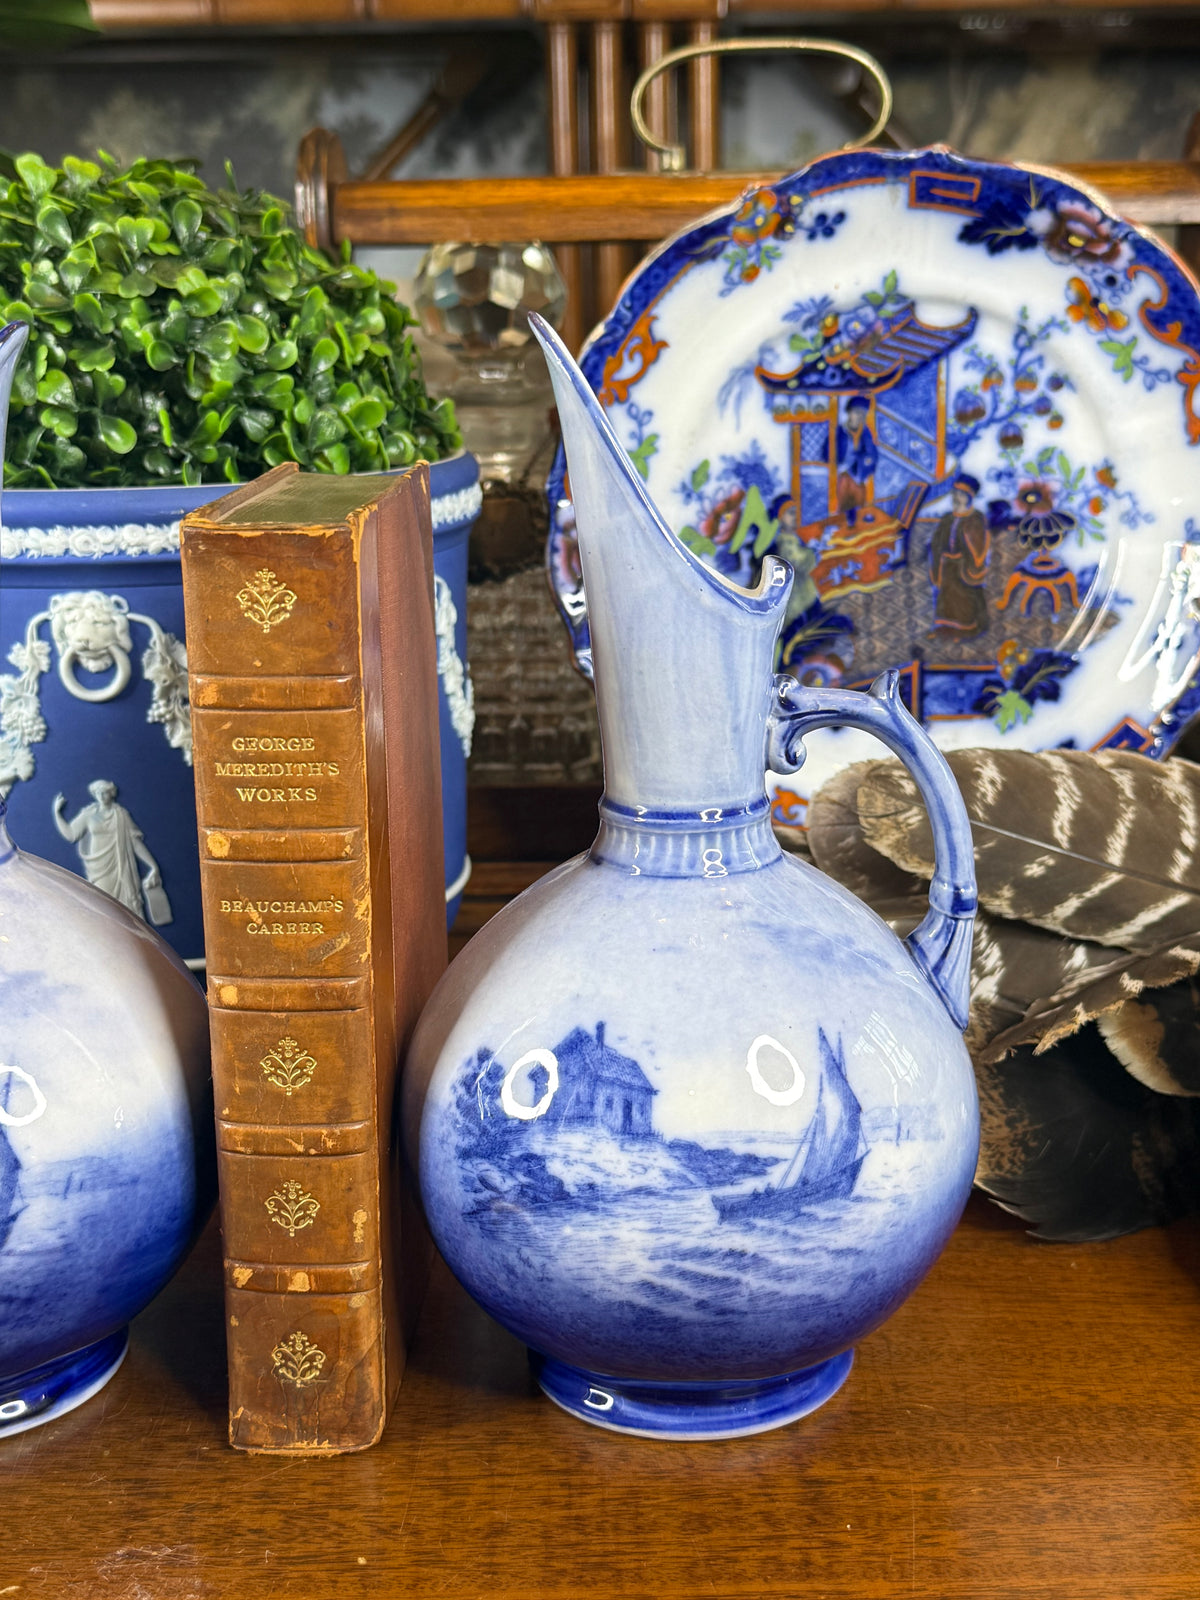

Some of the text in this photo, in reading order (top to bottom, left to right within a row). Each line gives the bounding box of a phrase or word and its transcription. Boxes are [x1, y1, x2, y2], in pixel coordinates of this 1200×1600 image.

[231, 737, 315, 751] GEORGE
[214, 762, 340, 777] MEREDITH'S
[236, 787, 318, 802] WORKS
[220, 895, 344, 913] BEAUCHAMP'S
[246, 922, 325, 935] CAREER
